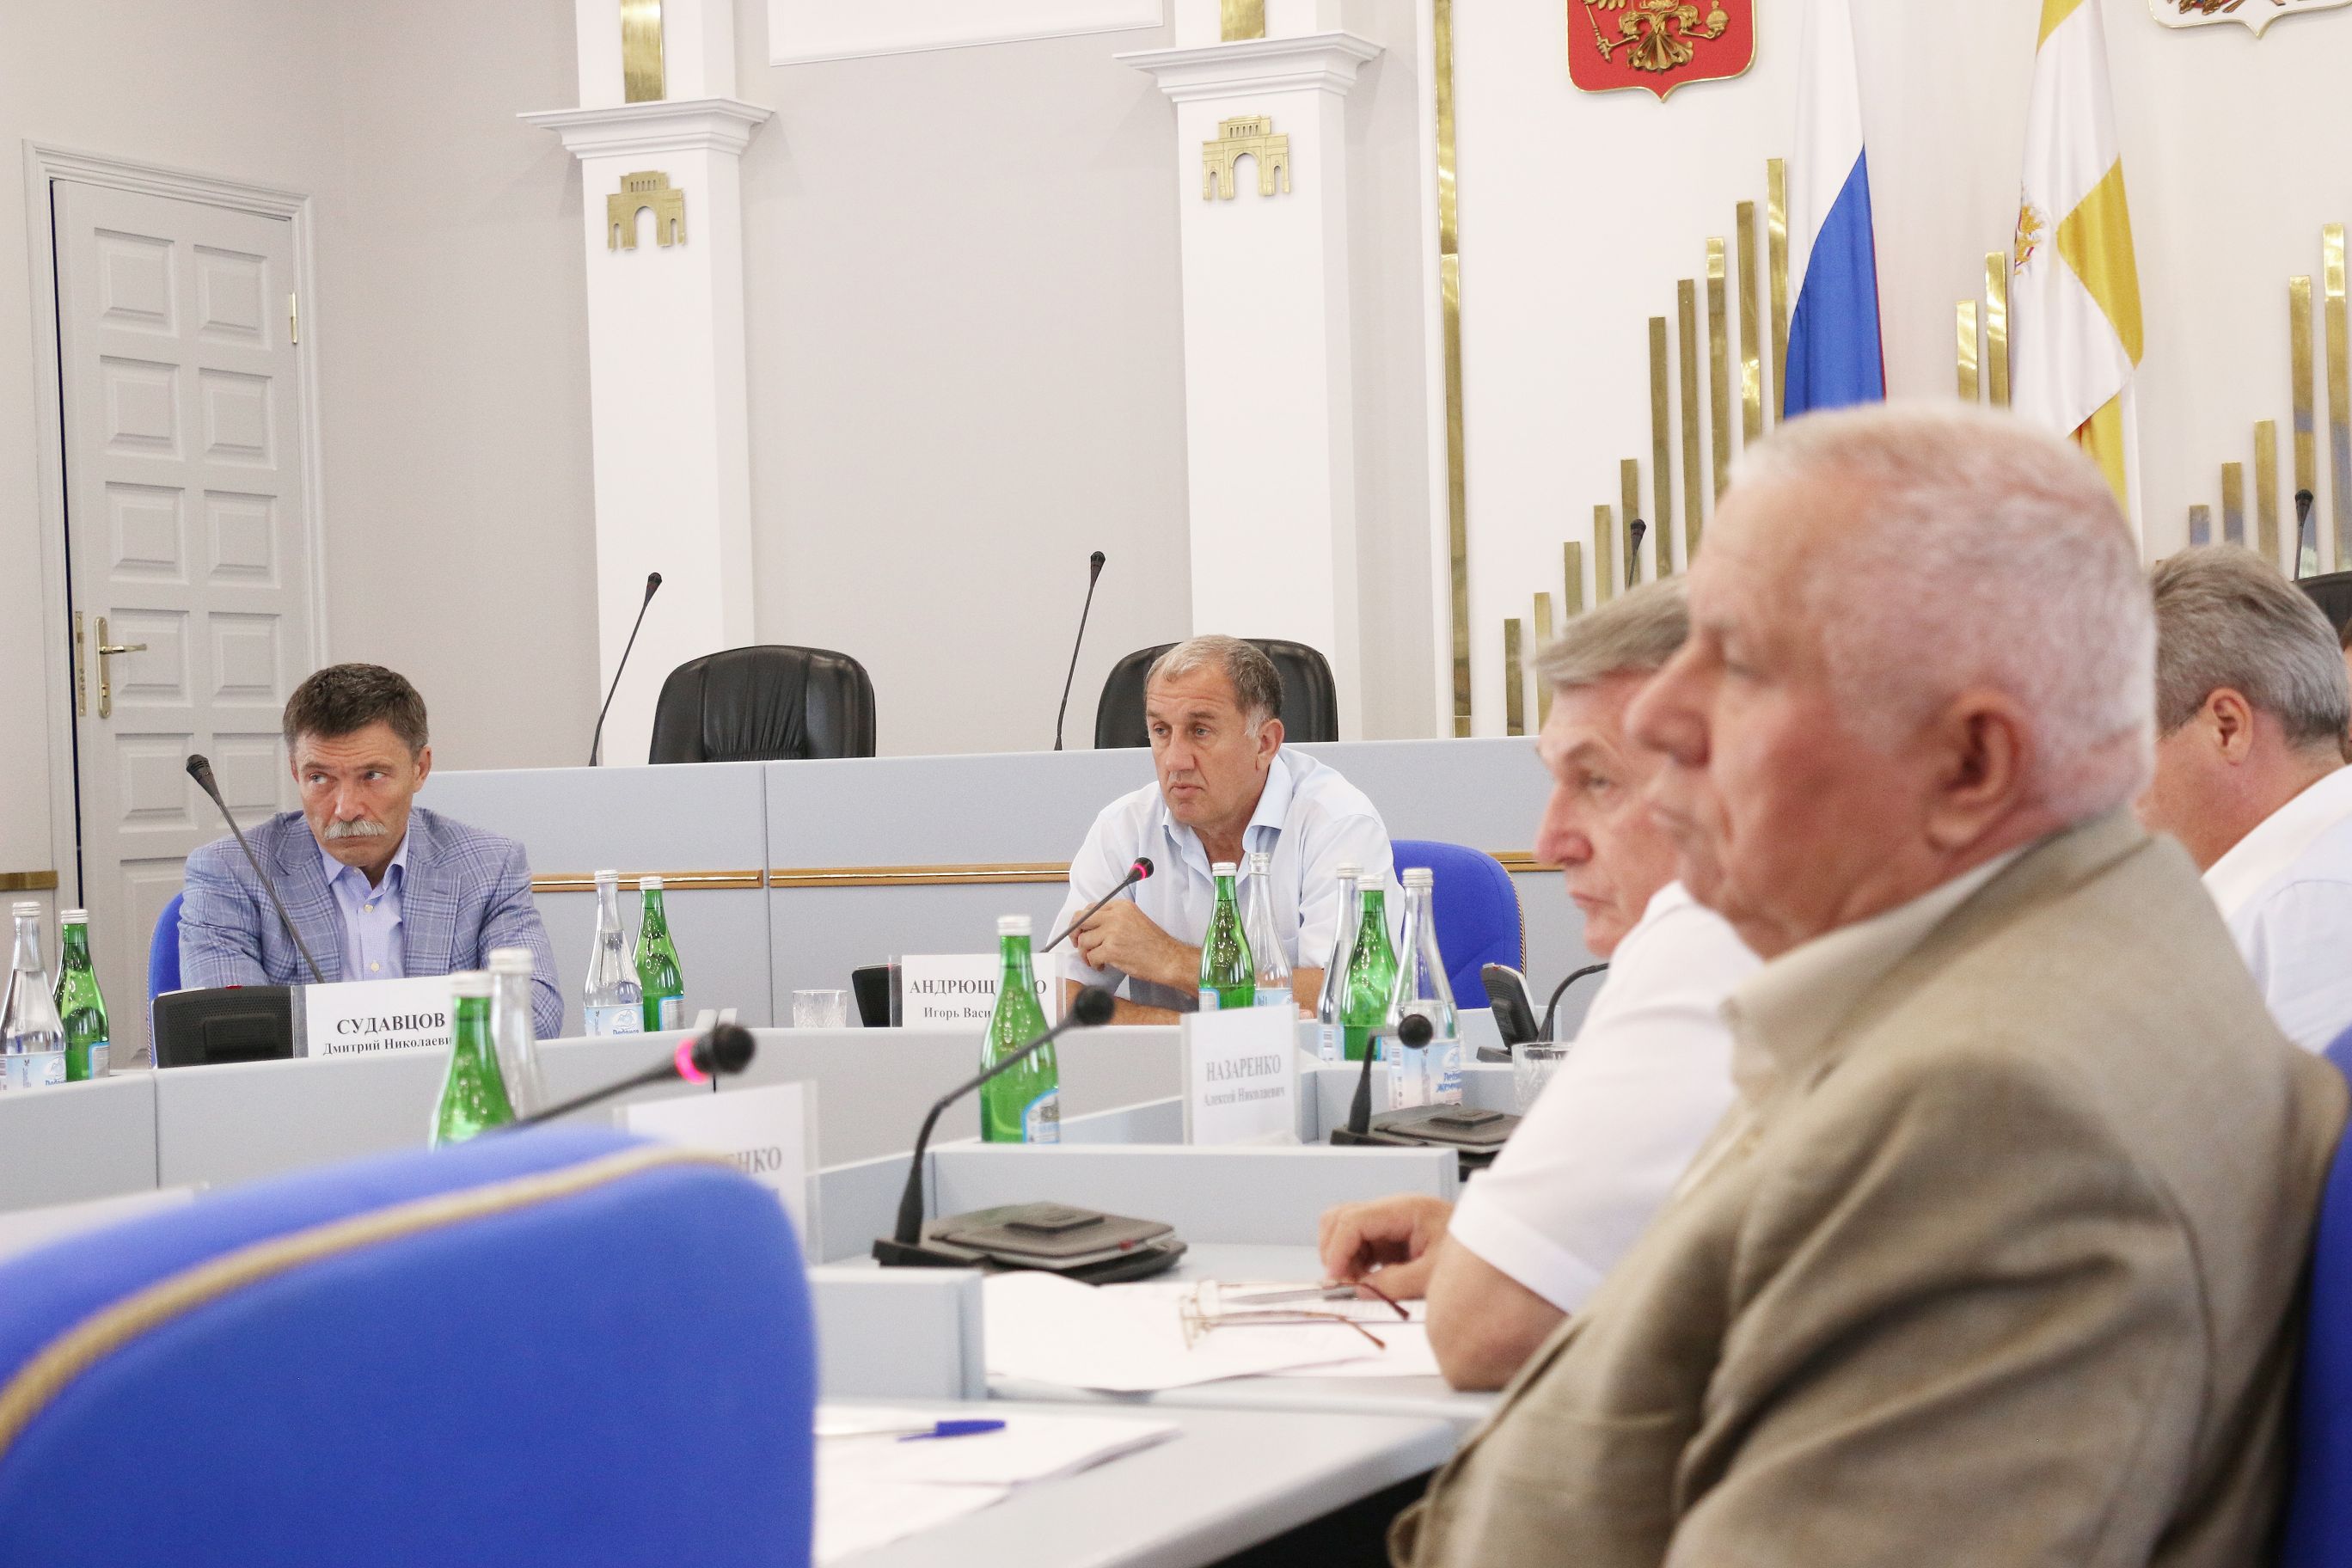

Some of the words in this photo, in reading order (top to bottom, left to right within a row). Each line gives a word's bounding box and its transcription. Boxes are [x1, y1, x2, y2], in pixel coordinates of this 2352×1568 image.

[910, 979, 1047, 995] АНДРЮЩО
[336, 1012, 446, 1036] СУДАВЦОВ
[923, 1007, 960, 1021] Игорь
[322, 1039, 381, 1057] Дмитрий
[384, 1037, 452, 1050] Николаеви
[1205, 1054, 1282, 1082] НАЗАРЕНКО
